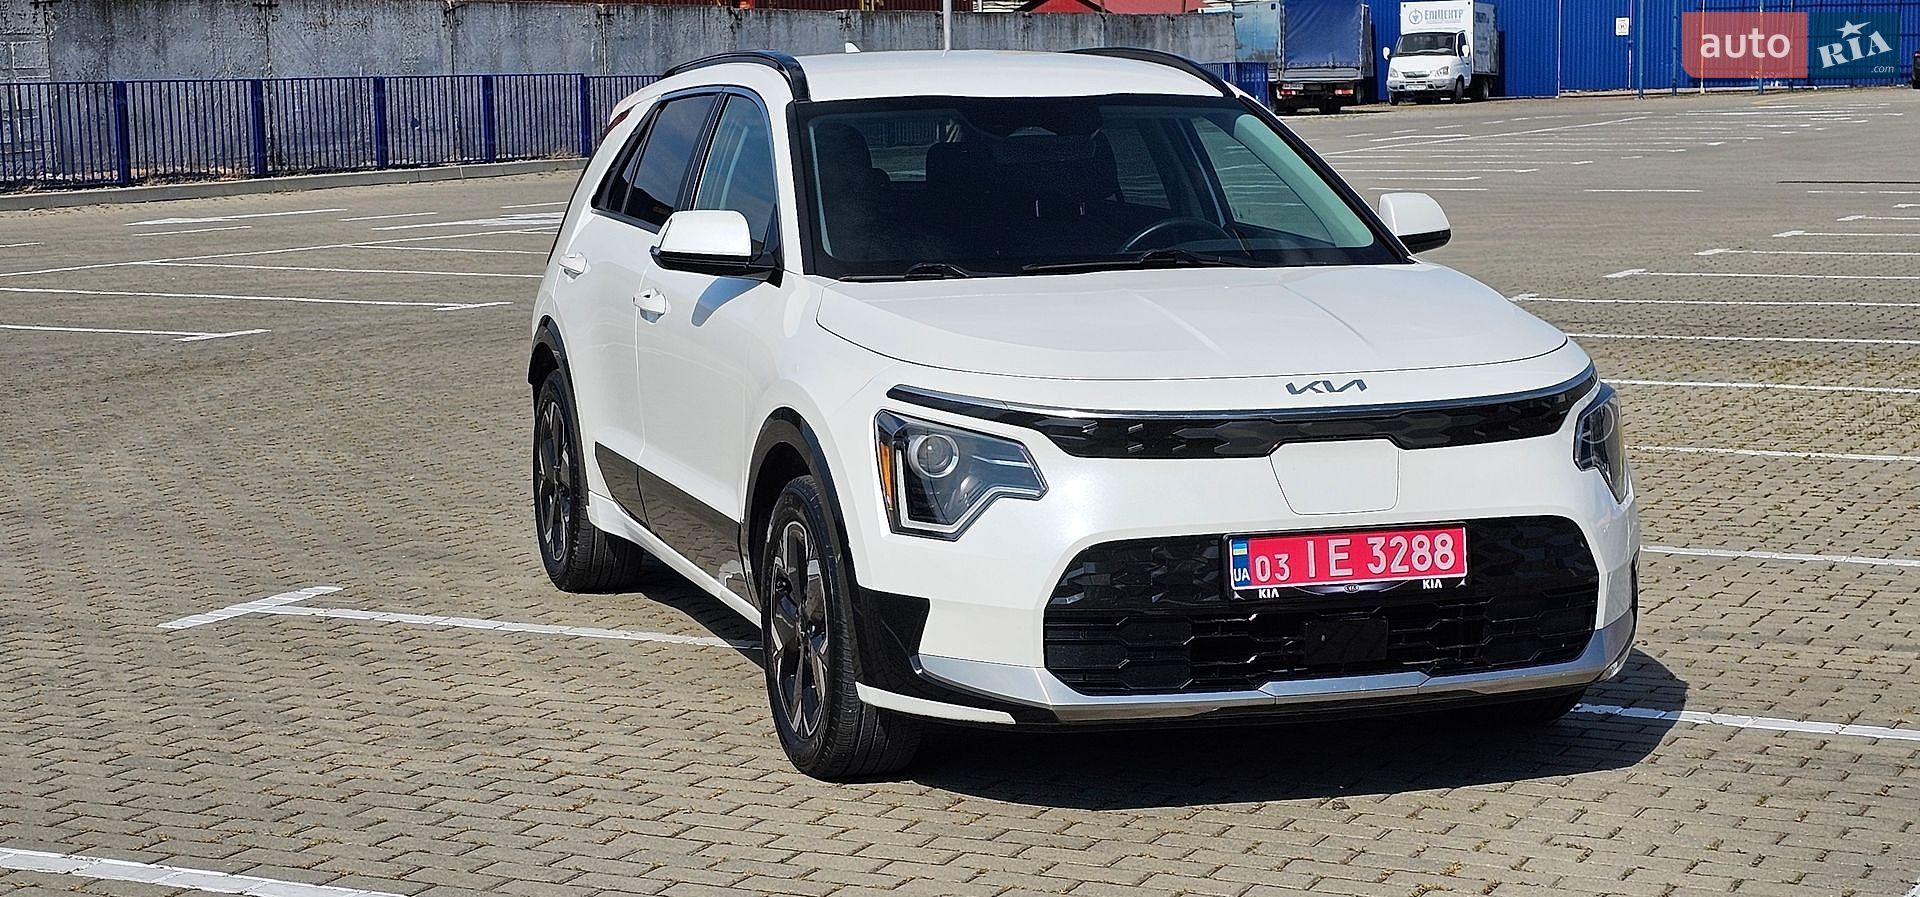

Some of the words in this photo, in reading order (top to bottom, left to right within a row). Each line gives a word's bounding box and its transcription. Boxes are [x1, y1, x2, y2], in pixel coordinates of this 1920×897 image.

[1285, 379, 1367, 395] KIA
[1254, 553, 1290, 583] 03
[1366, 532, 1456, 575] 3288
[1233, 567, 1251, 582] UA
[1422, 578, 1443, 590] KIA
[1258, 587, 1280, 599] KIA
